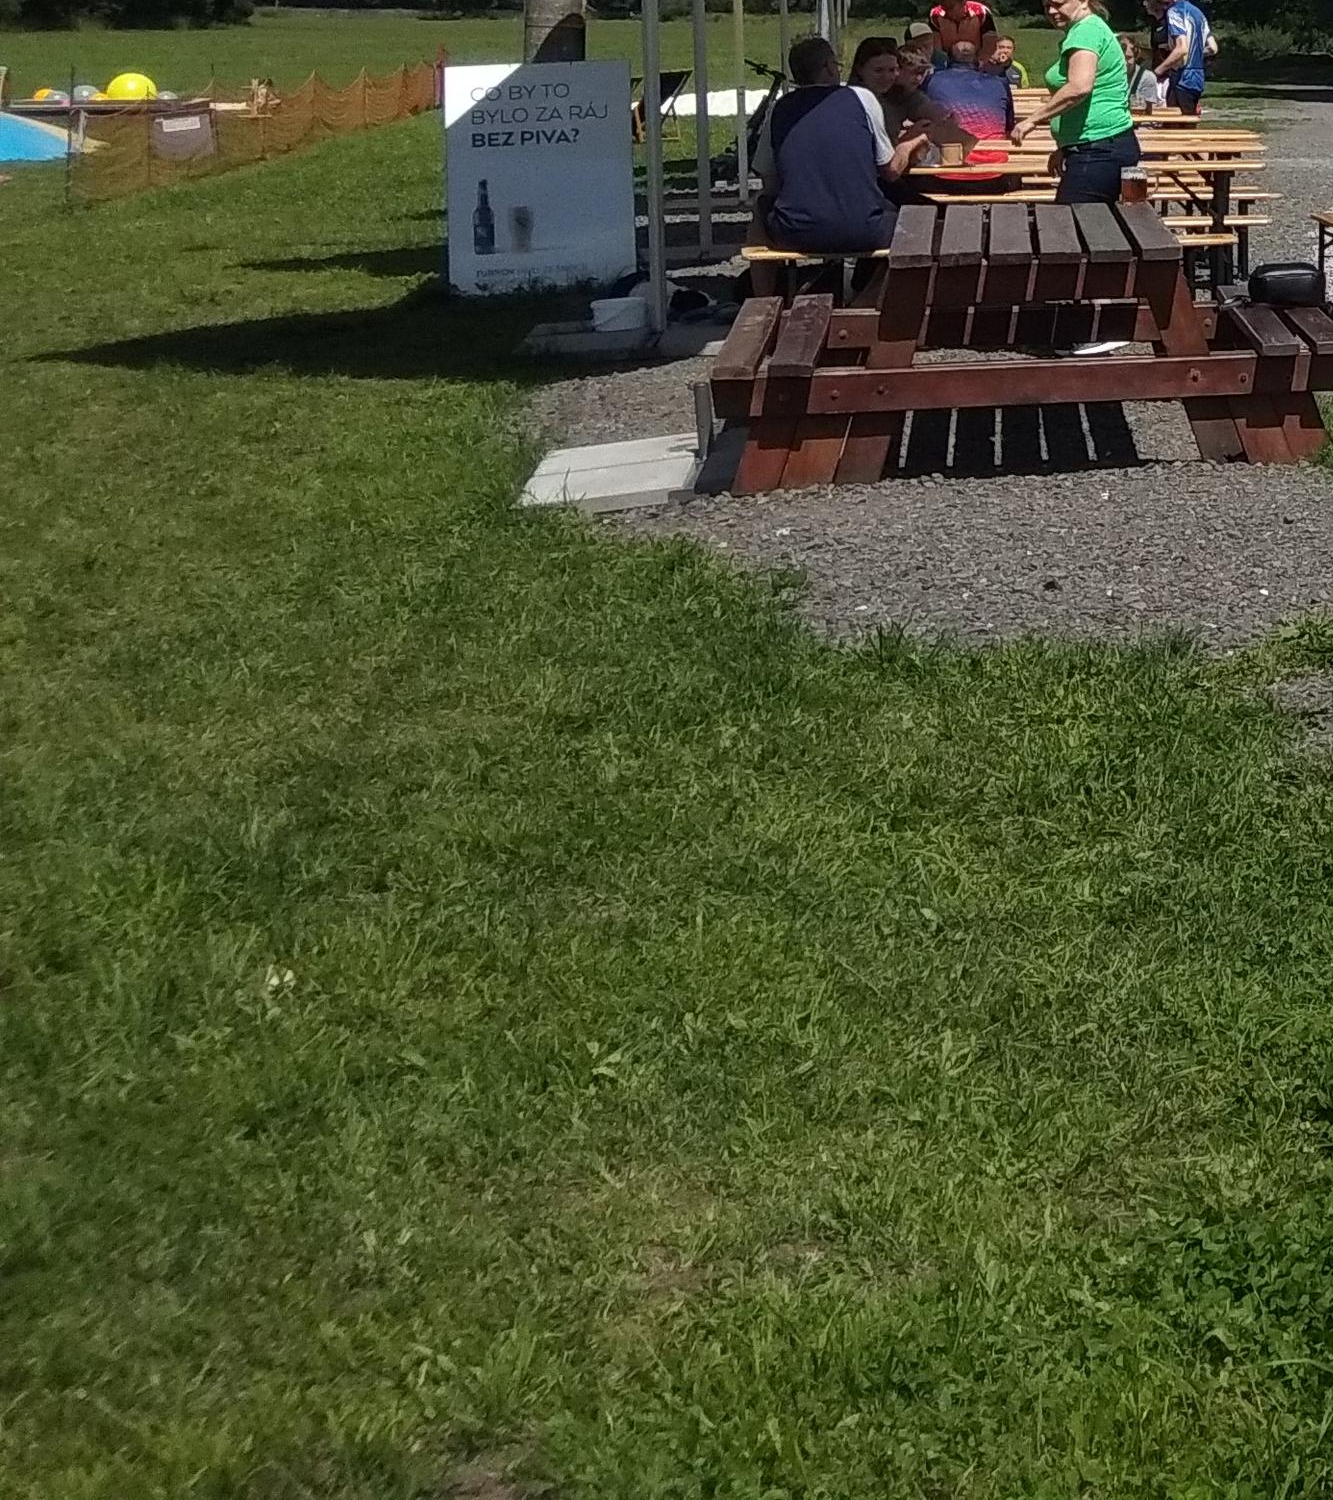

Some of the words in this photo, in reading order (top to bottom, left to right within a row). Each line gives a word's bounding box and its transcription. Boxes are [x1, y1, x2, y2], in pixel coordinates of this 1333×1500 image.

[470, 86, 502, 102] CO
[508, 85, 539, 101] BY
[541, 82, 571, 99] TO
[471, 107, 529, 126] BYLO
[535, 105, 564, 122] ZA
[568, 101, 609, 120] RÁJ
[471, 131, 515, 148] BEZ
[520, 128, 581, 146] PIVA?
